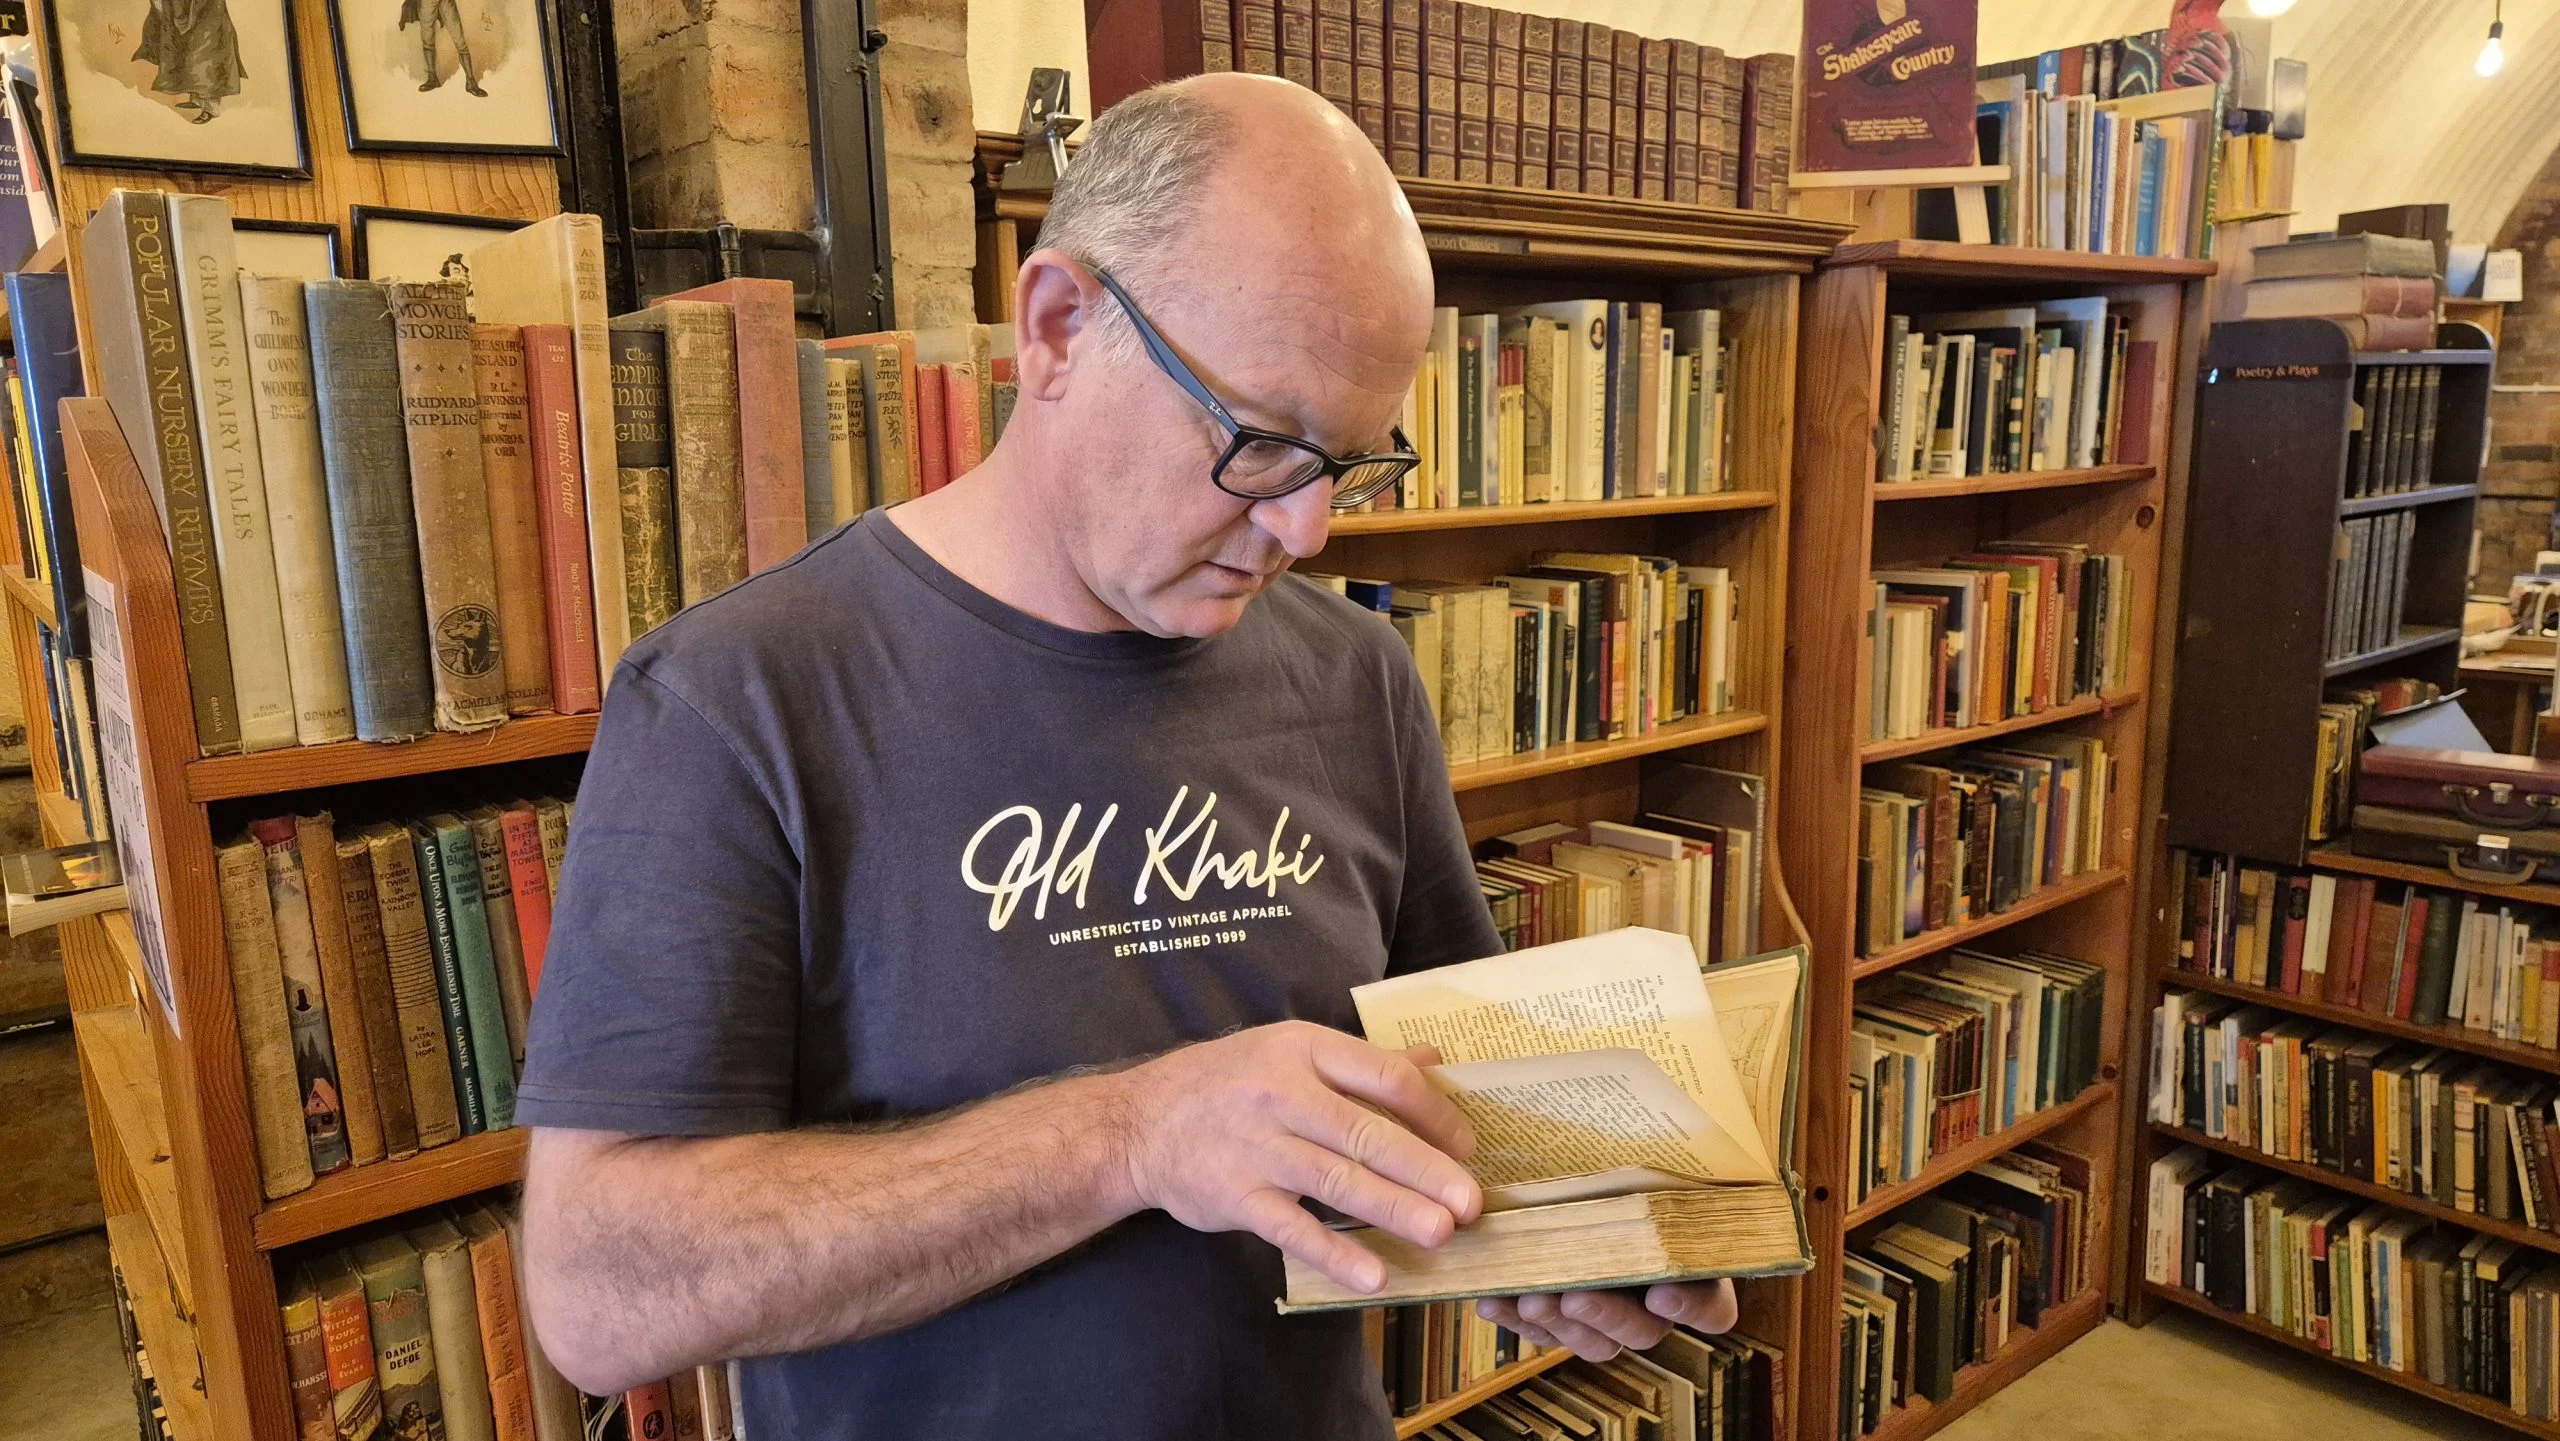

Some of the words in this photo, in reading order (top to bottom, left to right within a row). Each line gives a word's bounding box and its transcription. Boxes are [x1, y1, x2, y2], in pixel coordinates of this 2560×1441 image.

[1823, 18, 1923, 81] Shakespeare
[1890, 44, 1956, 81] Country
[133, 214, 177, 358] POPULAR
[199, 255, 230, 368] GRIMM'S
[267, 310, 290, 327] The
[400, 323, 471, 342] STORIES
[268, 357, 299, 373] OWN
[624, 348, 653, 362] The
[880, 358, 897, 368] THE
[610, 365, 664, 385] EMPIR
[2235, 367, 2275, 381] Poetry
[2276, 366, 2286, 378] &
[2287, 364, 2319, 378] Plays
[261, 381, 310, 398] WONDER
[886, 381, 896, 389] OF
[406, 396, 478, 409] RUDYARD
[1594, 360, 1605, 449] MILTON
[214, 378, 242, 454] FAIRY
[408, 413, 480, 427] KIPLING
[631, 410, 657, 420] FOR
[154, 366, 197, 498] NURSERY
[498, 422, 509, 433] by
[615, 423, 668, 442] GIRLS
[555, 410, 575, 468] Beatrix
[225, 464, 254, 541] TALES
[560, 472, 575, 518] Potter
[175, 506, 216, 625] RHYMES
[508, 824, 520, 834] IN
[522, 819, 539, 831] THE
[512, 829, 539, 842] FIFTH
[387, 861, 402, 869] THE
[425, 845, 438, 870] ONCE
[512, 853, 543, 866] TOWERS
[960, 801, 1118, 932] Old
[1133, 784, 1325, 905] Khaki
[429, 871, 443, 898] UPON
[491, 873, 500, 881] OF
[386, 900, 416, 913] VALLEY
[433, 899, 442, 908] A
[435, 907, 449, 934] MORE
[1049, 918, 1162, 946] UNRESTRICTED
[1167, 910, 1227, 929] VINTAGE
[1232, 904, 1292, 921] APPAREL
[1114, 934, 1211, 958] ESTABLISHED
[1215, 929, 1247, 945] 1999
[440, 935, 459, 997] ENLIGHTENED
[450, 996, 463, 1019] TIME
[408, 1031, 437, 1043] LAURA
[417, 1041, 433, 1049] LEE
[455, 1026, 470, 1070] GARNER
[464, 1077, 479, 1126] MACMILLAN
[328, 1334, 366, 1354] POSTER
[385, 1339, 423, 1360] DANIEL
[389, 1350, 421, 1372] DEFOE
